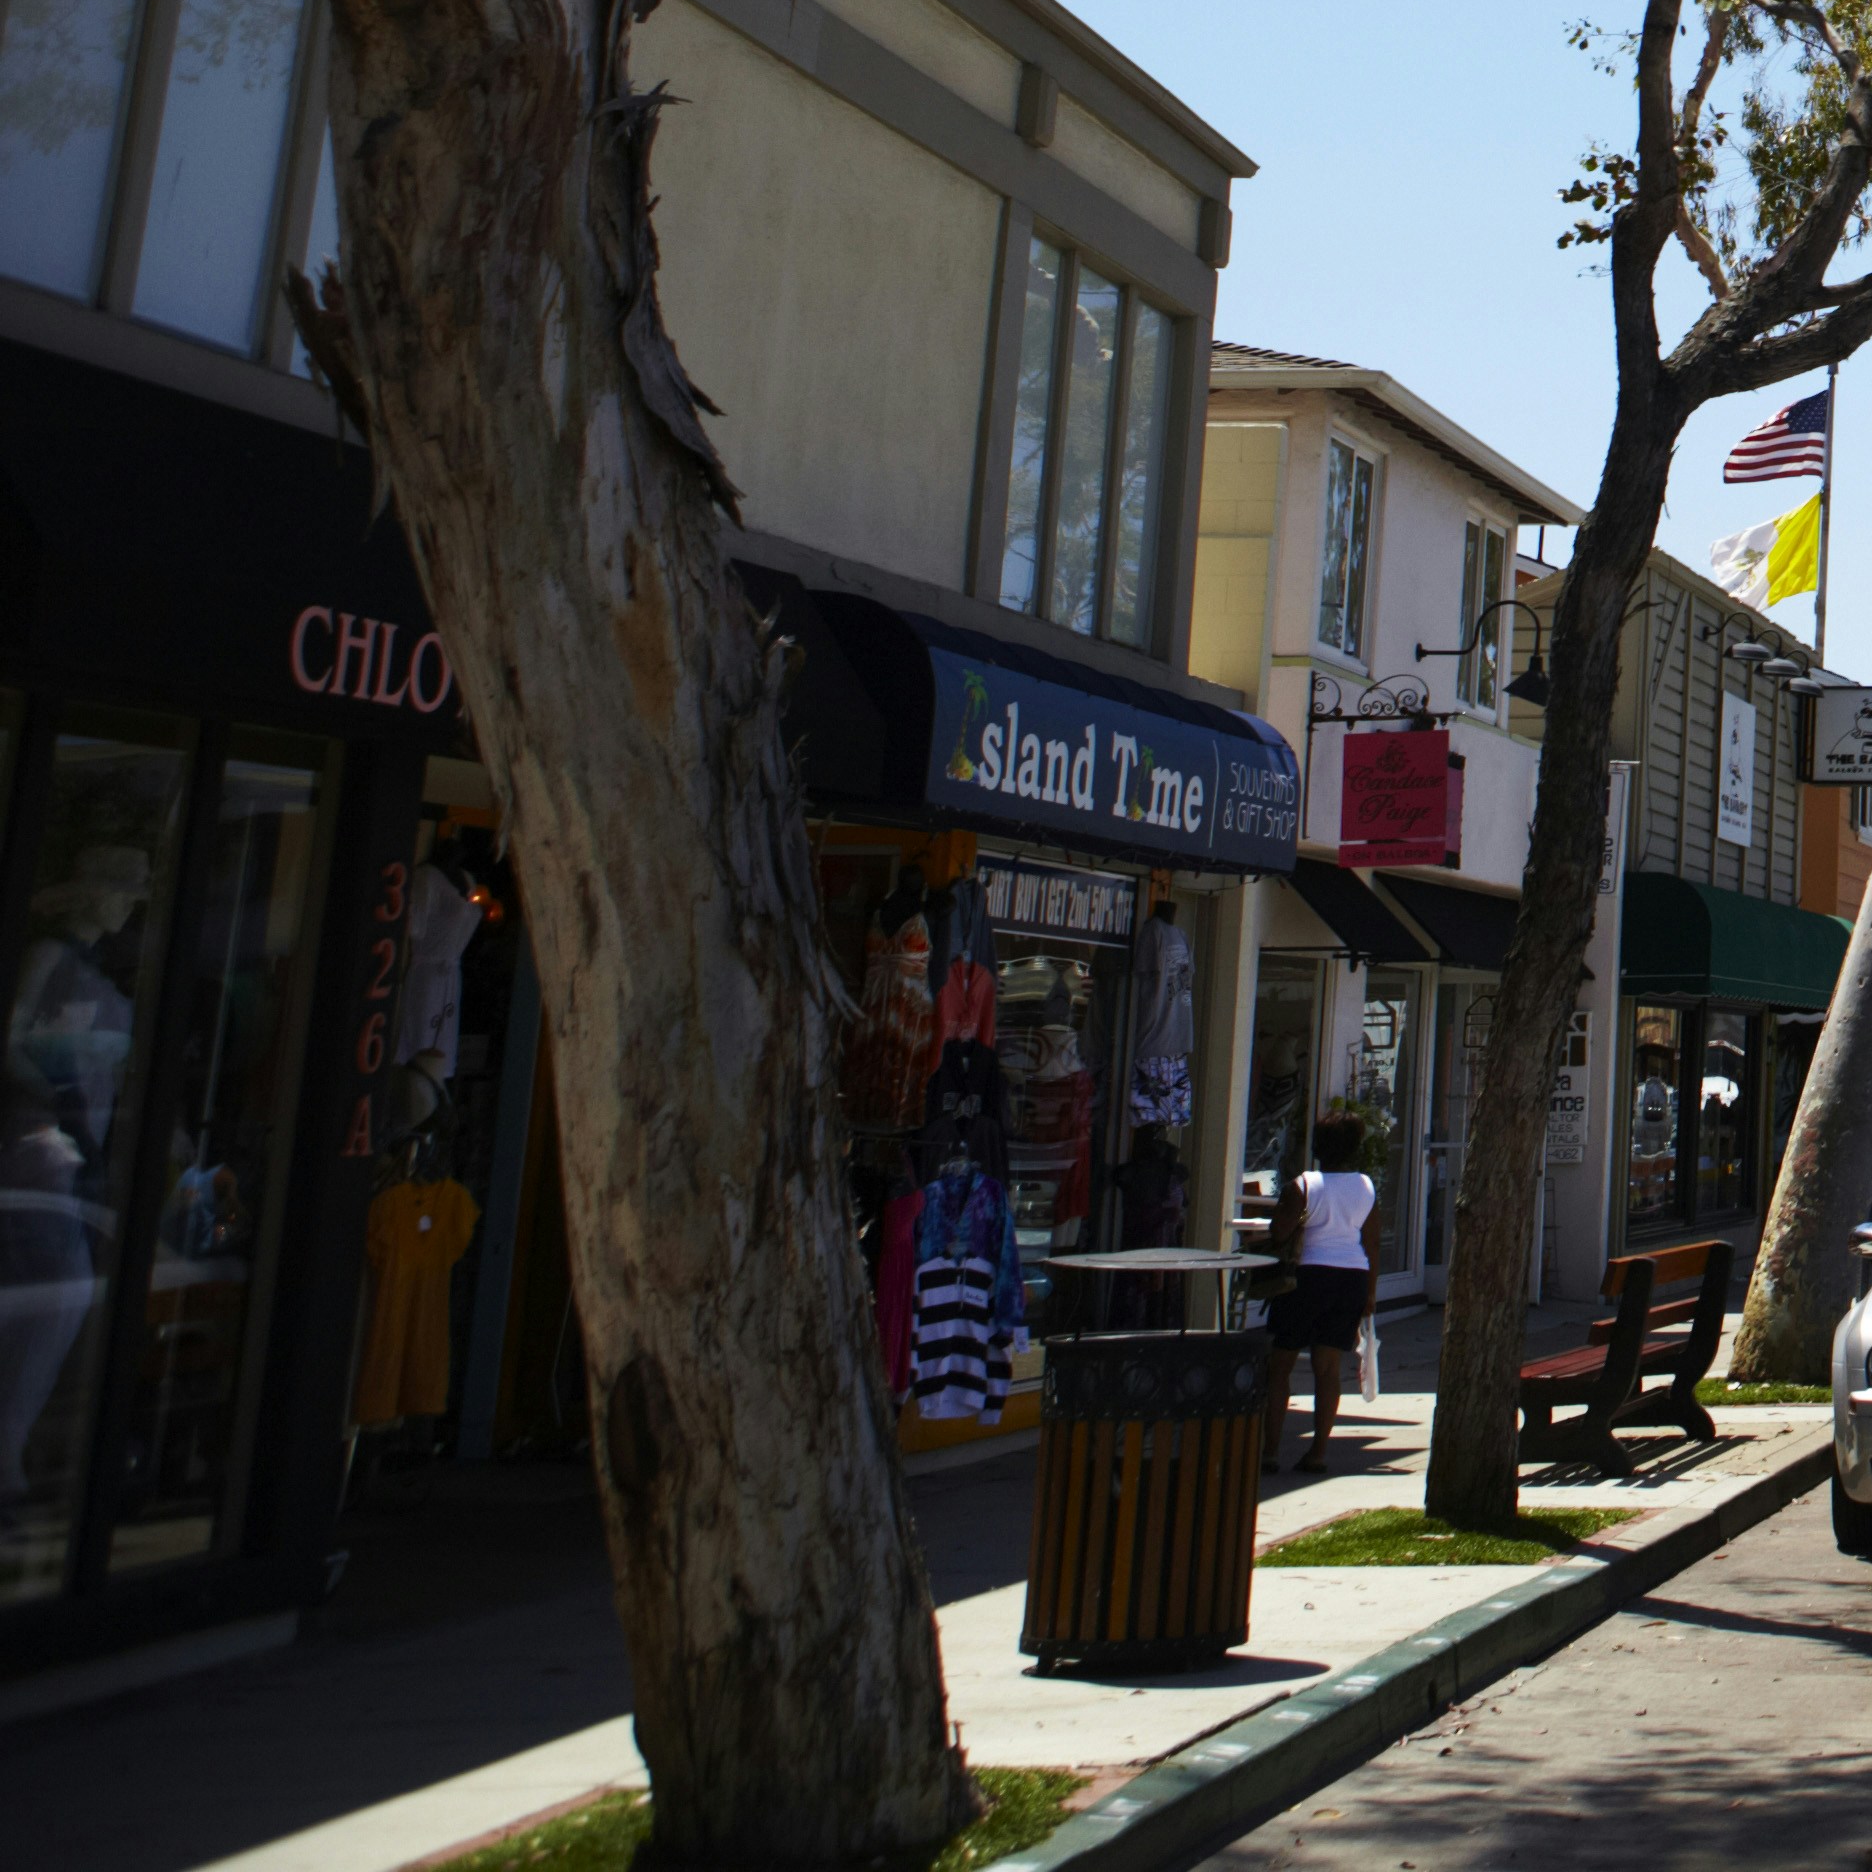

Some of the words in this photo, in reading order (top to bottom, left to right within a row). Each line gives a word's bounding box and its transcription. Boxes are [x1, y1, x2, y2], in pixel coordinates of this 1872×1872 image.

[289, 604, 470, 719] CHLO
[1222, 799, 1233, 830] &
[1236, 801, 1263, 835] GIFT
[1263, 807, 1297, 842] SHOP
